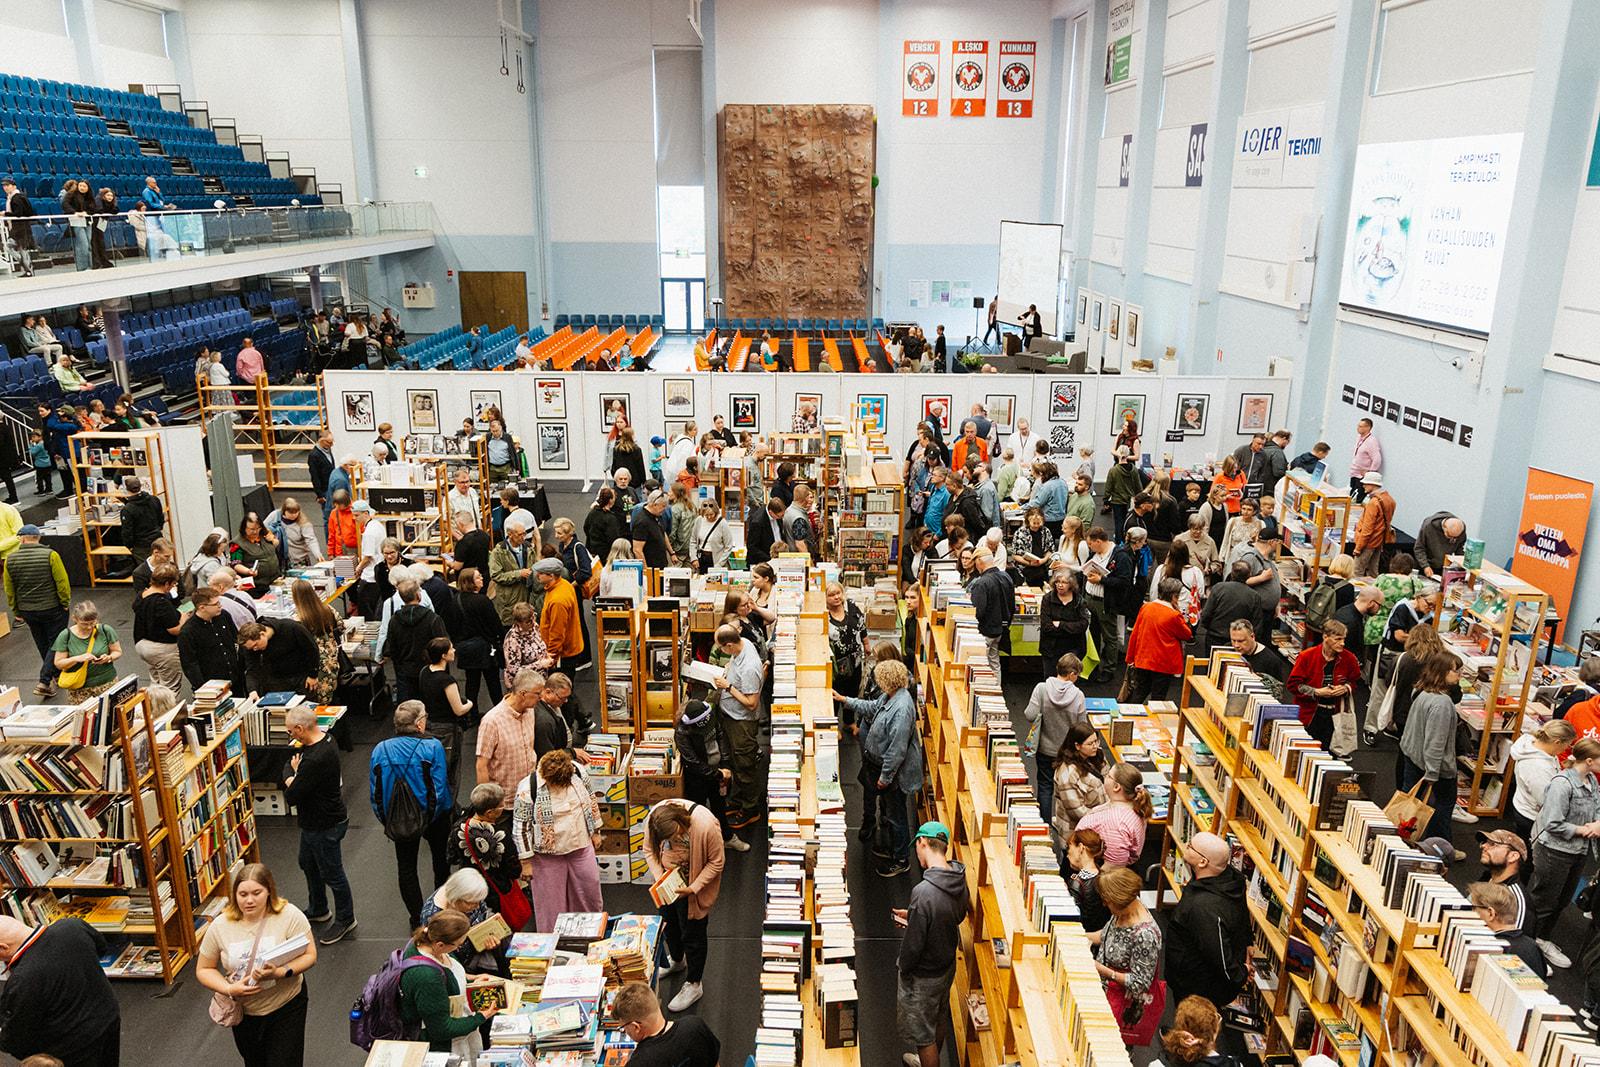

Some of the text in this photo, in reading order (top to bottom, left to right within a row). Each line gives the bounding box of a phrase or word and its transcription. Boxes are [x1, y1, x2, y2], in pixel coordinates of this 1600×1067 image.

[913, 102, 927, 115] 12
[964, 101, 972, 114] 3
[1007, 102, 1022, 115] 13
[1242, 126, 1282, 156] LOJER
[1187, 132, 1206, 178] SA
[1534, 523, 1564, 539] TIETEEN
[1537, 537, 1556, 551] OMA
[1518, 544, 1569, 569] KIRJAKAUPPA
